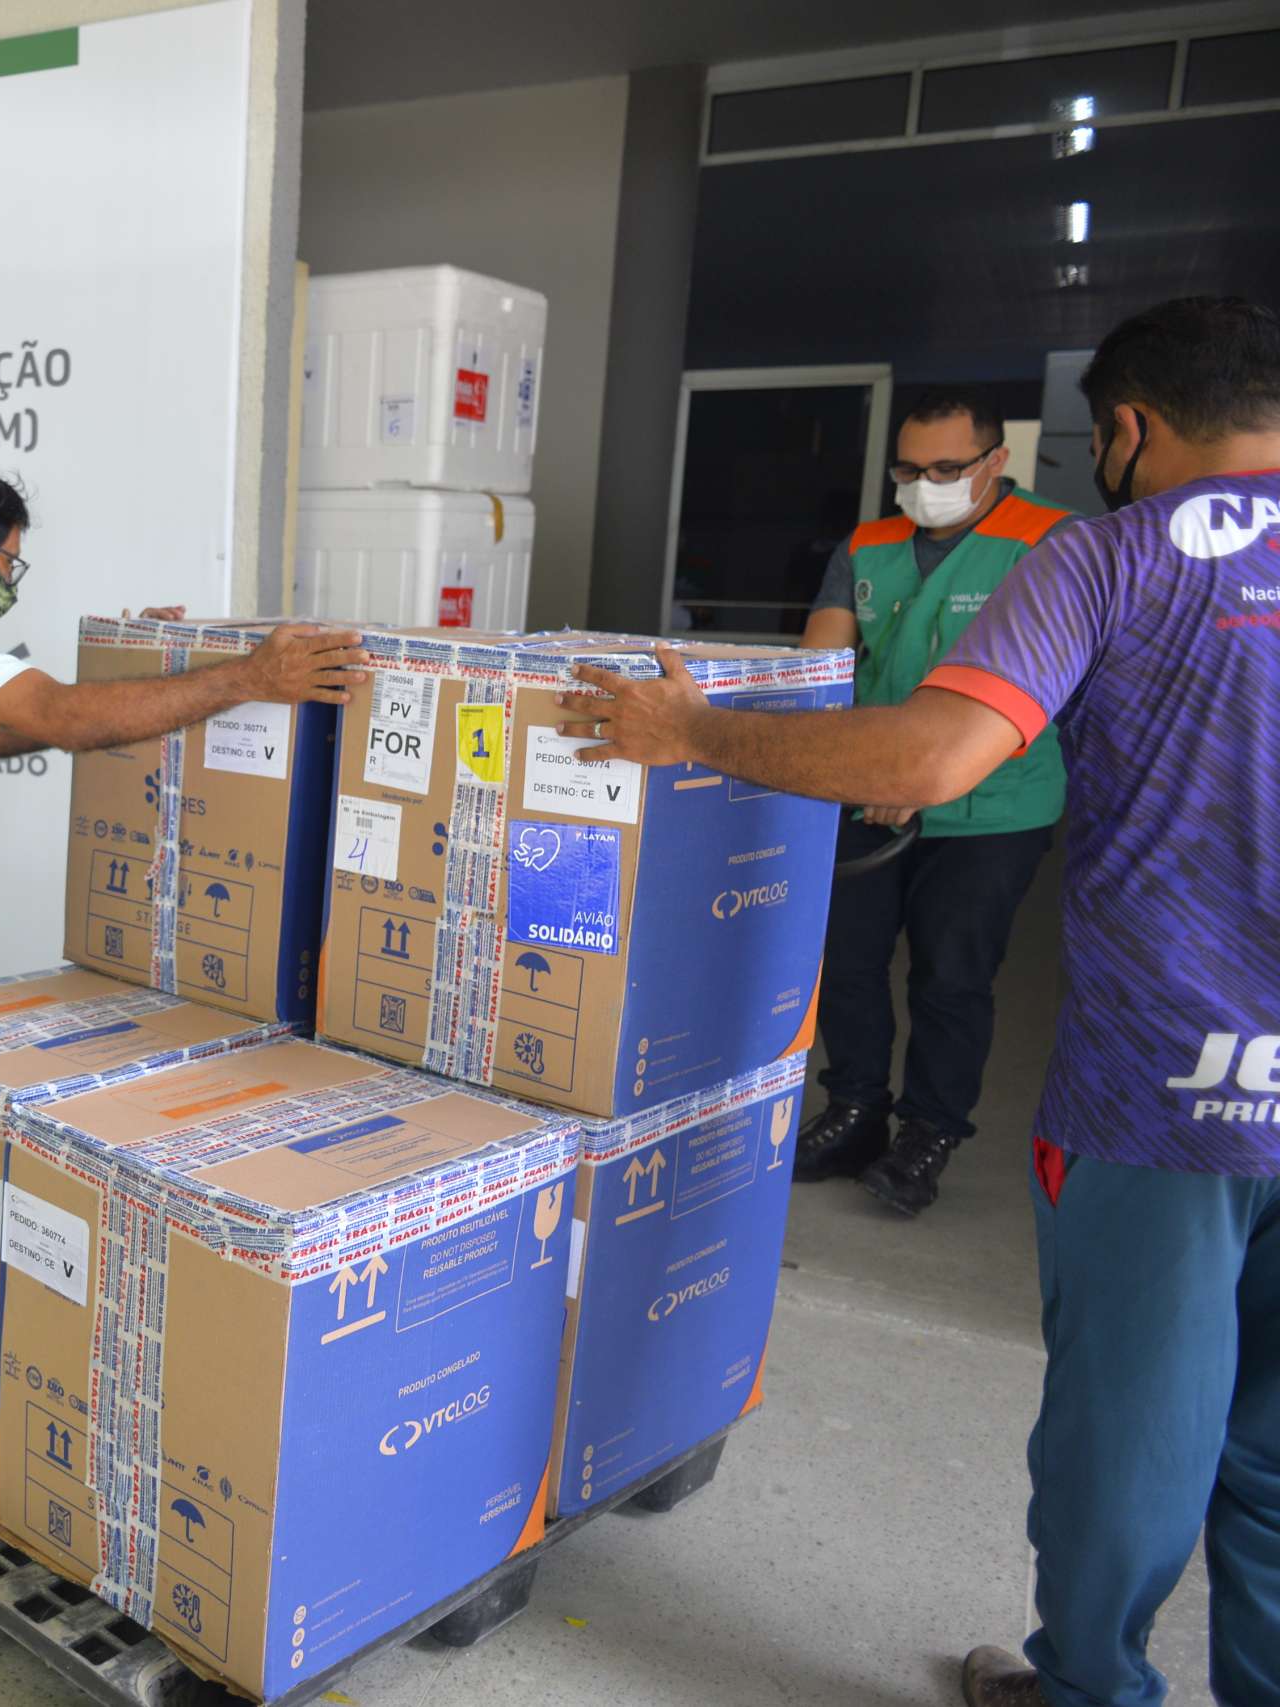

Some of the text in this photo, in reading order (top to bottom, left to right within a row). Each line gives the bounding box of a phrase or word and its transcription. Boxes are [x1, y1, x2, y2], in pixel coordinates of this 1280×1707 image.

[390, 702, 412, 719] PV
[246, 748, 257, 759] CE
[264, 746, 275, 760] V
[370, 728, 421, 760] FOR
[472, 728, 490, 758] 1
[535, 752, 574, 765] PEDIDO:
[533, 782, 621, 801] DESTINO: CE V
[583, 831, 616, 842] LATAM
[348, 838, 368, 870] 4
[742, 880, 789, 909] VTCLOG
[574, 911, 614, 927] AVIÃO
[528, 923, 614, 949] SOLIDÁRIO
[9, 1210, 39, 1234] PEDIDO:
[421, 1209, 509, 1250] PRODUTO REUTILIZÁVEL
[9, 1239, 75, 1280] DESTINO: CE V
[423, 1241, 499, 1280] REUSABLE PRODUCT
[430, 1230, 496, 1264] DO NOT DISPOSED
[678, 1267, 730, 1304] VTCLOG
[398, 1351, 481, 1398] PRODUTO CONGELADO
[423, 1385, 491, 1435] VTCLOG
[479, 1495, 522, 1525] PERISHABLE
